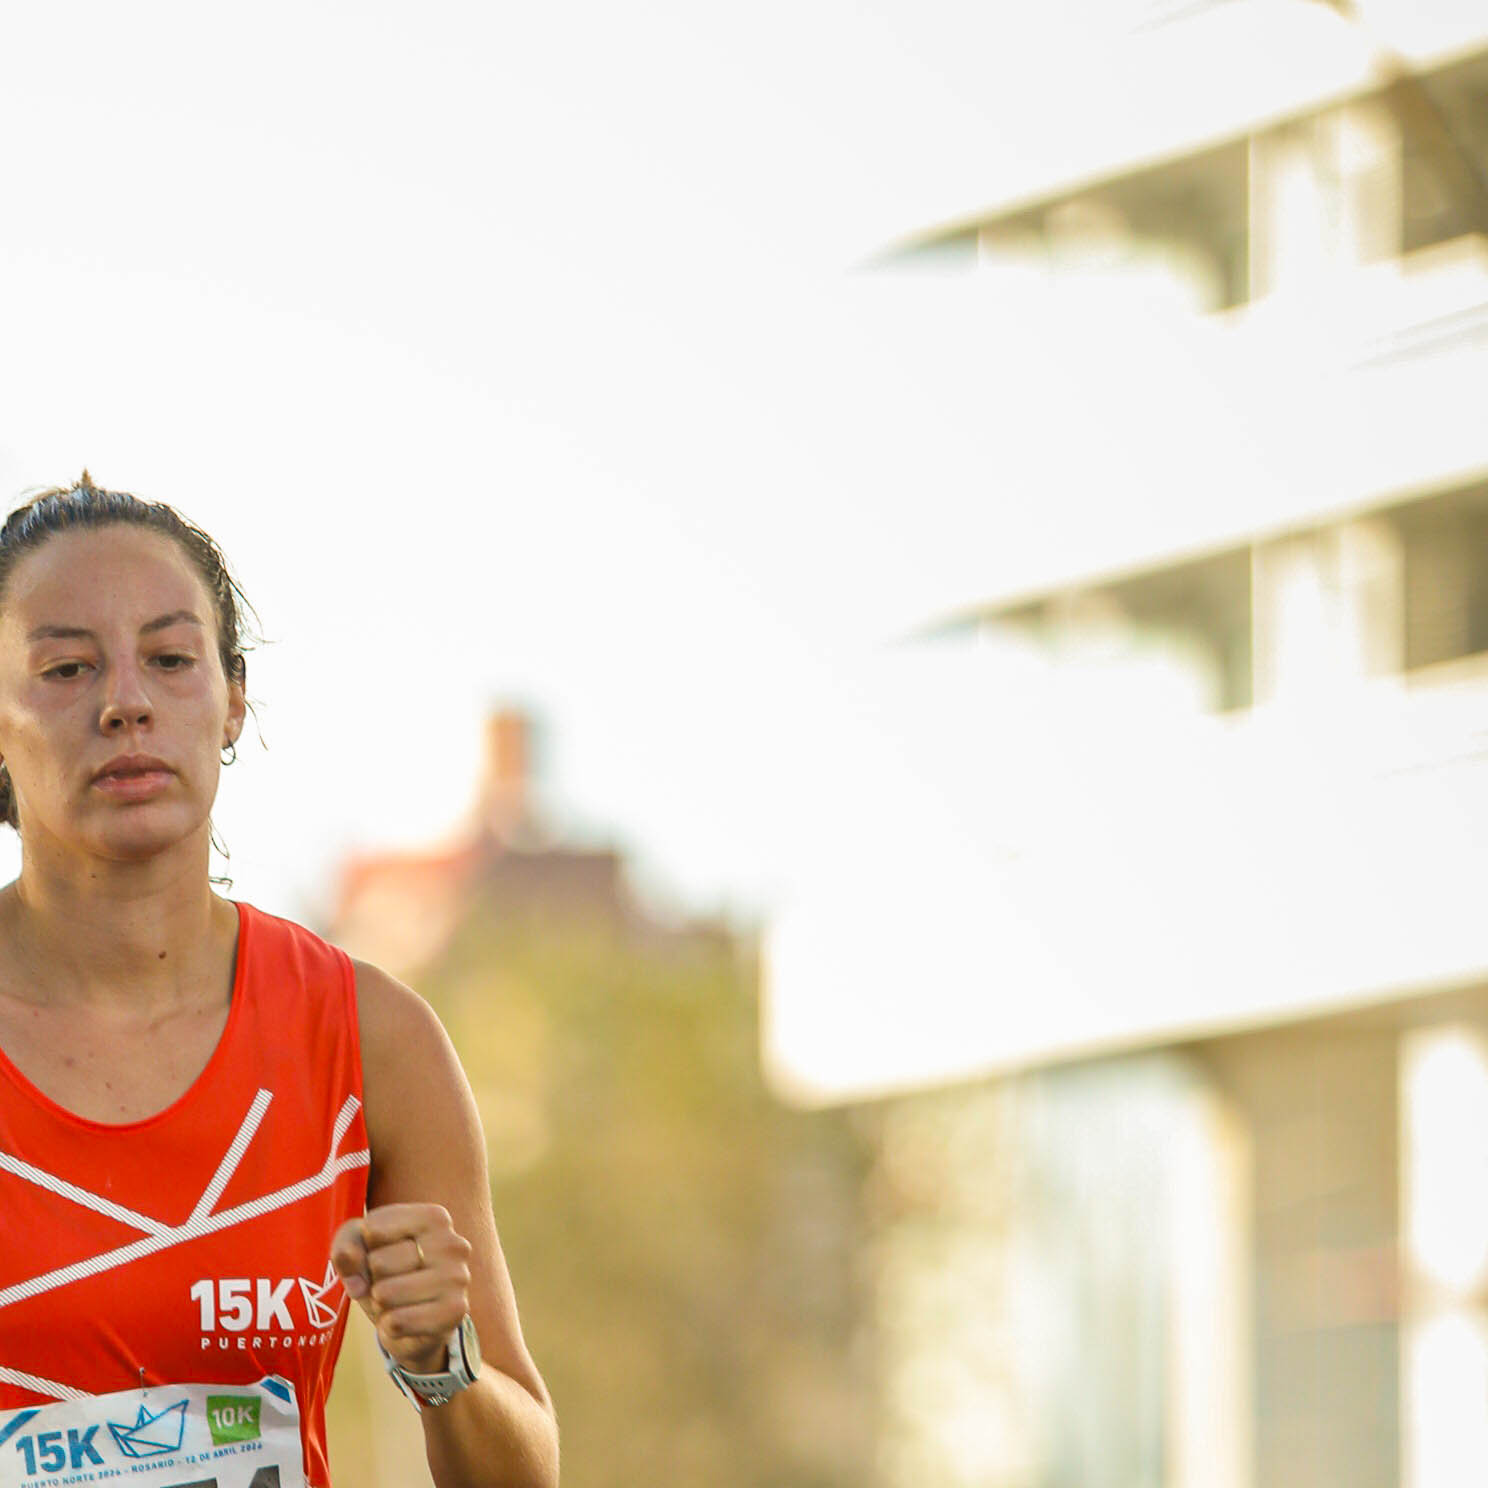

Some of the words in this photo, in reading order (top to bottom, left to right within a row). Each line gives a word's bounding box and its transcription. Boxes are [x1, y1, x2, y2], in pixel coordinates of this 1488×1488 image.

[190, 1278, 296, 1332] 15K
[212, 1405, 254, 1429] 10K
[15, 1424, 105, 1476] 15K
[62, 1473, 95, 1485] NORTE
[131, 1459, 174, 1473] ROSARIO
[199, 1452, 210, 1461] DE
[213, 1447, 237, 1459] ABRIL
